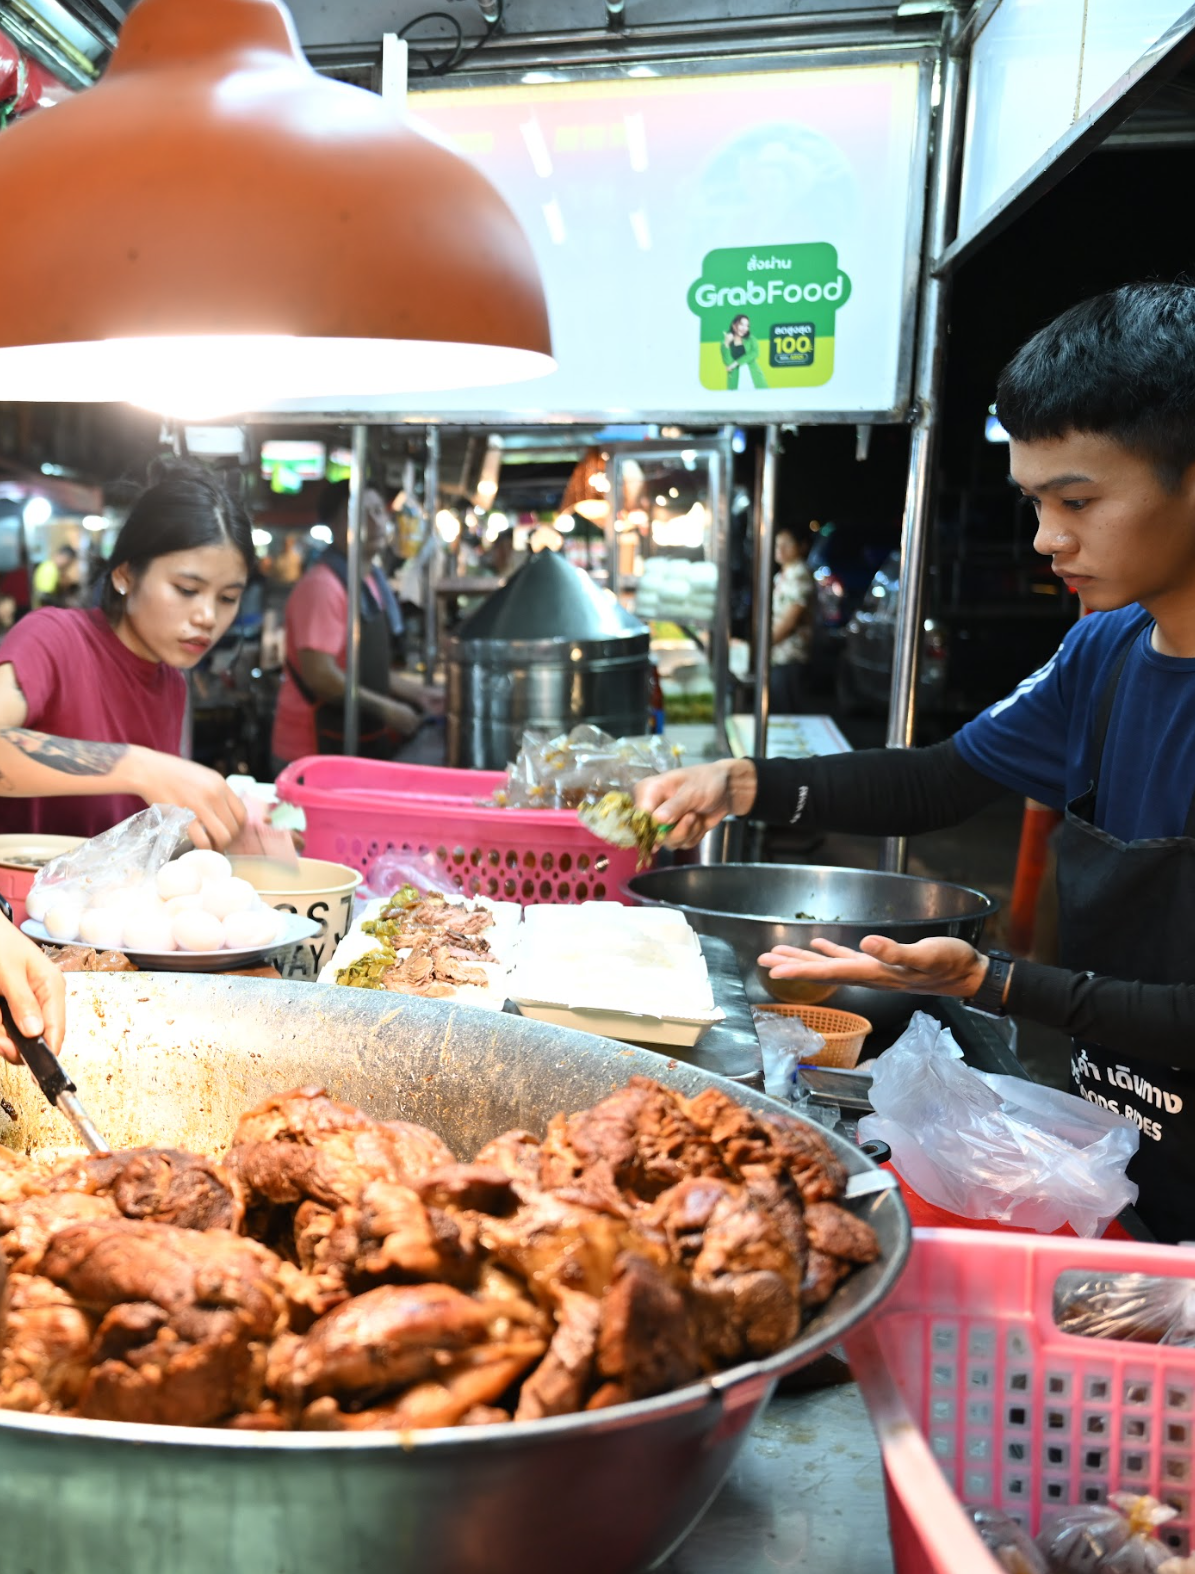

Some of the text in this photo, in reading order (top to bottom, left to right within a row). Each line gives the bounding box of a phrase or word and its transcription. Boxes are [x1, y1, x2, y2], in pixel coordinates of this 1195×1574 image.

[746, 254, 792, 271] สั่งผ่าน
[694, 274, 844, 308] GrabFood
[773, 336, 811, 354] 100
